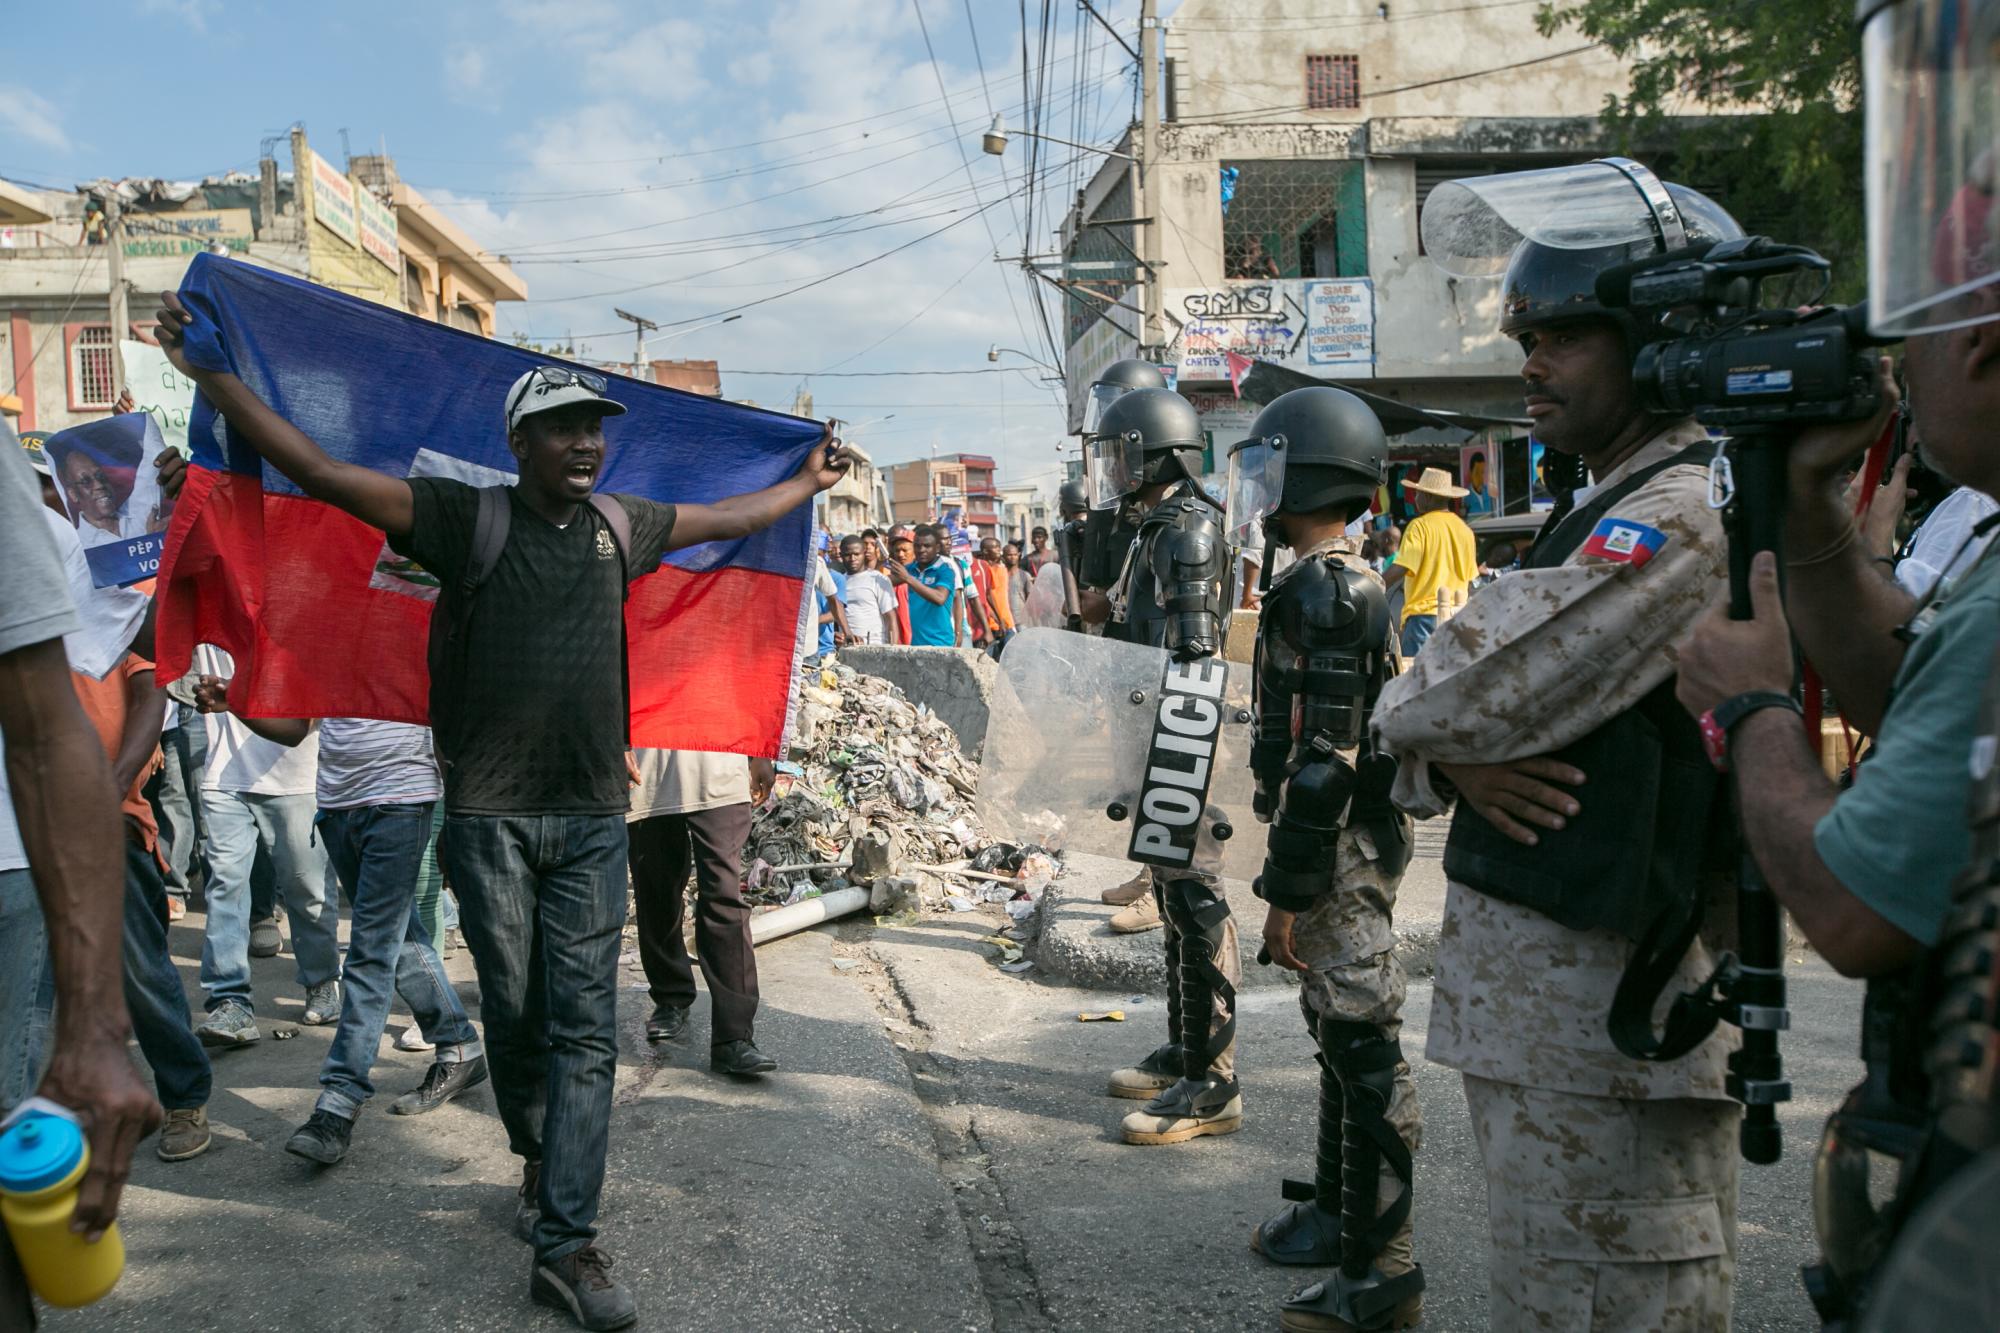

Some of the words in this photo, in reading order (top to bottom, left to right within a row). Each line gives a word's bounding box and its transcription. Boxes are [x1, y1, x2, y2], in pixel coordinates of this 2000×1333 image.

[1323, 286, 1352, 295] SMS
[1184, 286, 1272, 316] SMS
[1185, 357, 1220, 367] CARTES
[128, 541, 153, 557] PÈP
[138, 557, 161, 573] VO
[1134, 661, 1225, 860] POLICE
